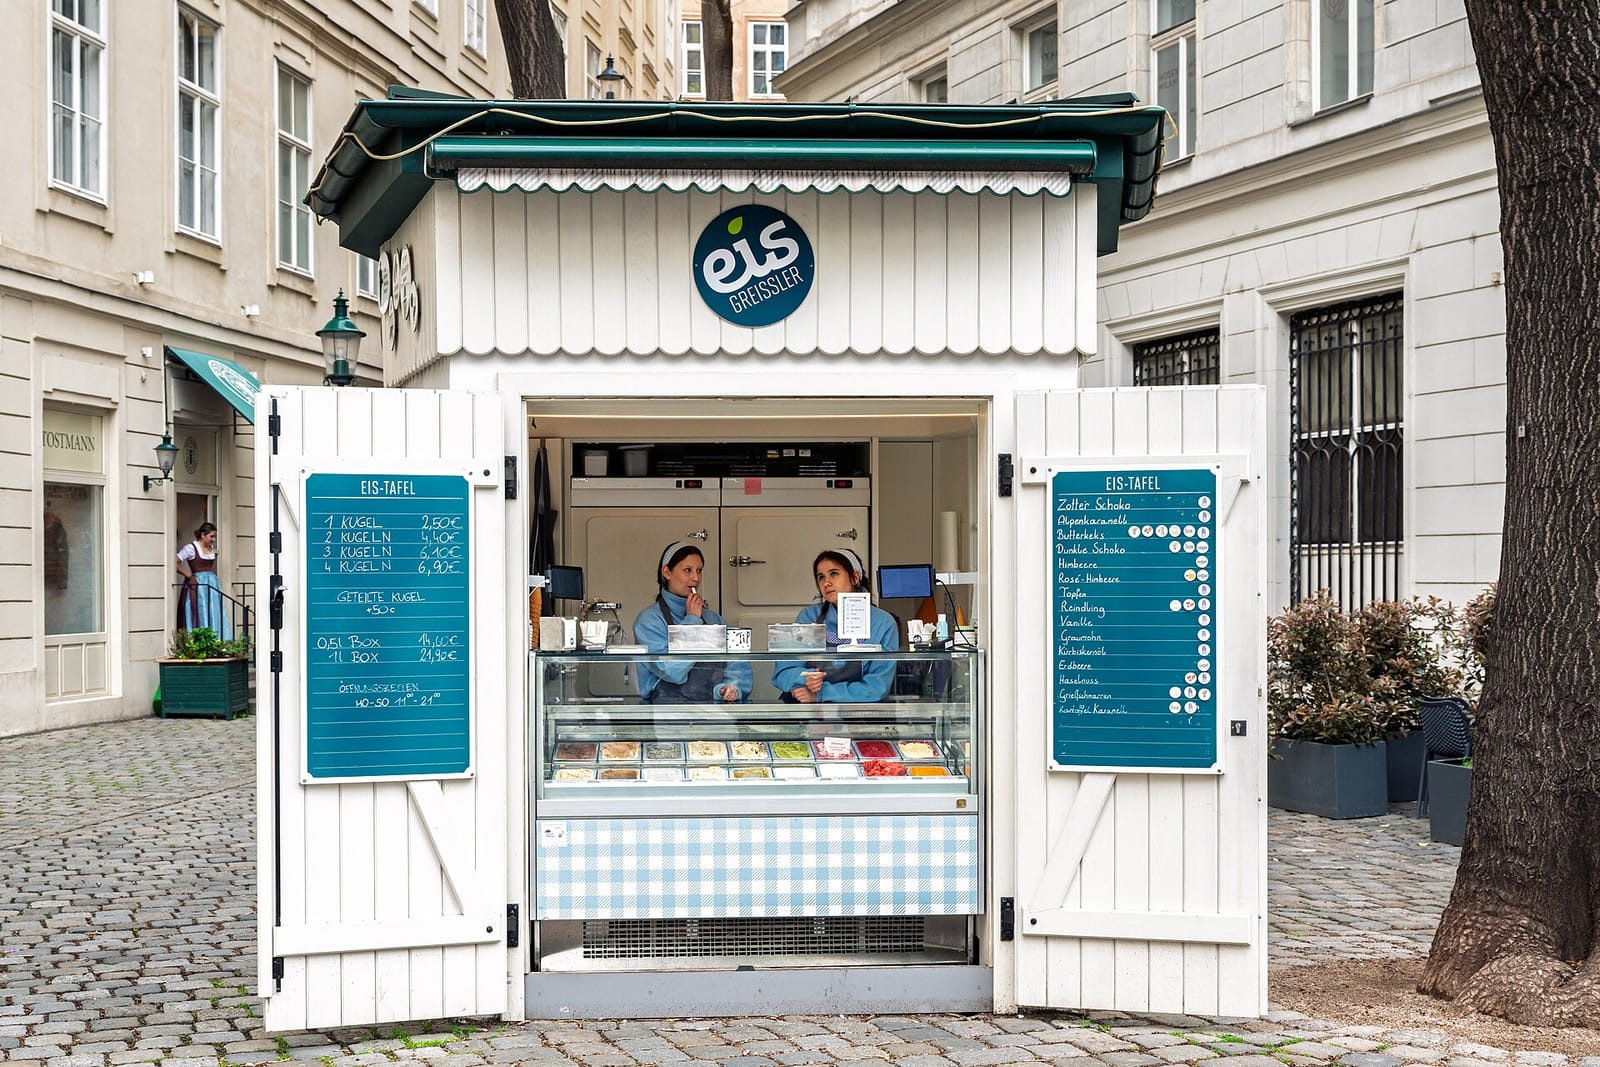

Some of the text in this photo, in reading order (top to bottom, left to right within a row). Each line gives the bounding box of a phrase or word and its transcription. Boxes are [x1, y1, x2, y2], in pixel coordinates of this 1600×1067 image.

[703, 217, 799, 293] eis
[729, 266, 804, 313] GREISSLER
[42, 430, 95, 452] TOSTMANN
[361, 480, 416, 495] EIS-TAFEL
[1105, 476, 1161, 491] EIS-TAFEL
[1095, 497, 1131, 510] Schoko
[324, 514, 462, 531] 1 KUGEL 2,50€
[324, 531, 461, 546] 2 KUGELN 4,40€
[1056, 528, 1105, 540] Butterkeks
[323, 546, 462, 560] 3 KUGELN 6,10€
[1056, 542, 1126, 554] Dunkle Schoko
[324, 560, 461, 576] 4 KUGELN 6,90€
[1058, 558, 1098, 569] Himbeere
[336, 591, 426, 603] GETEILTE KUGEL
[1059, 586, 1087, 600] Topfen
[1061, 600, 1106, 618] Reindling
[1060, 615, 1093, 627] Vanille
[1058, 659, 1092, 670] Erdbeere
[1059, 673, 1099, 685] Haselnuss
